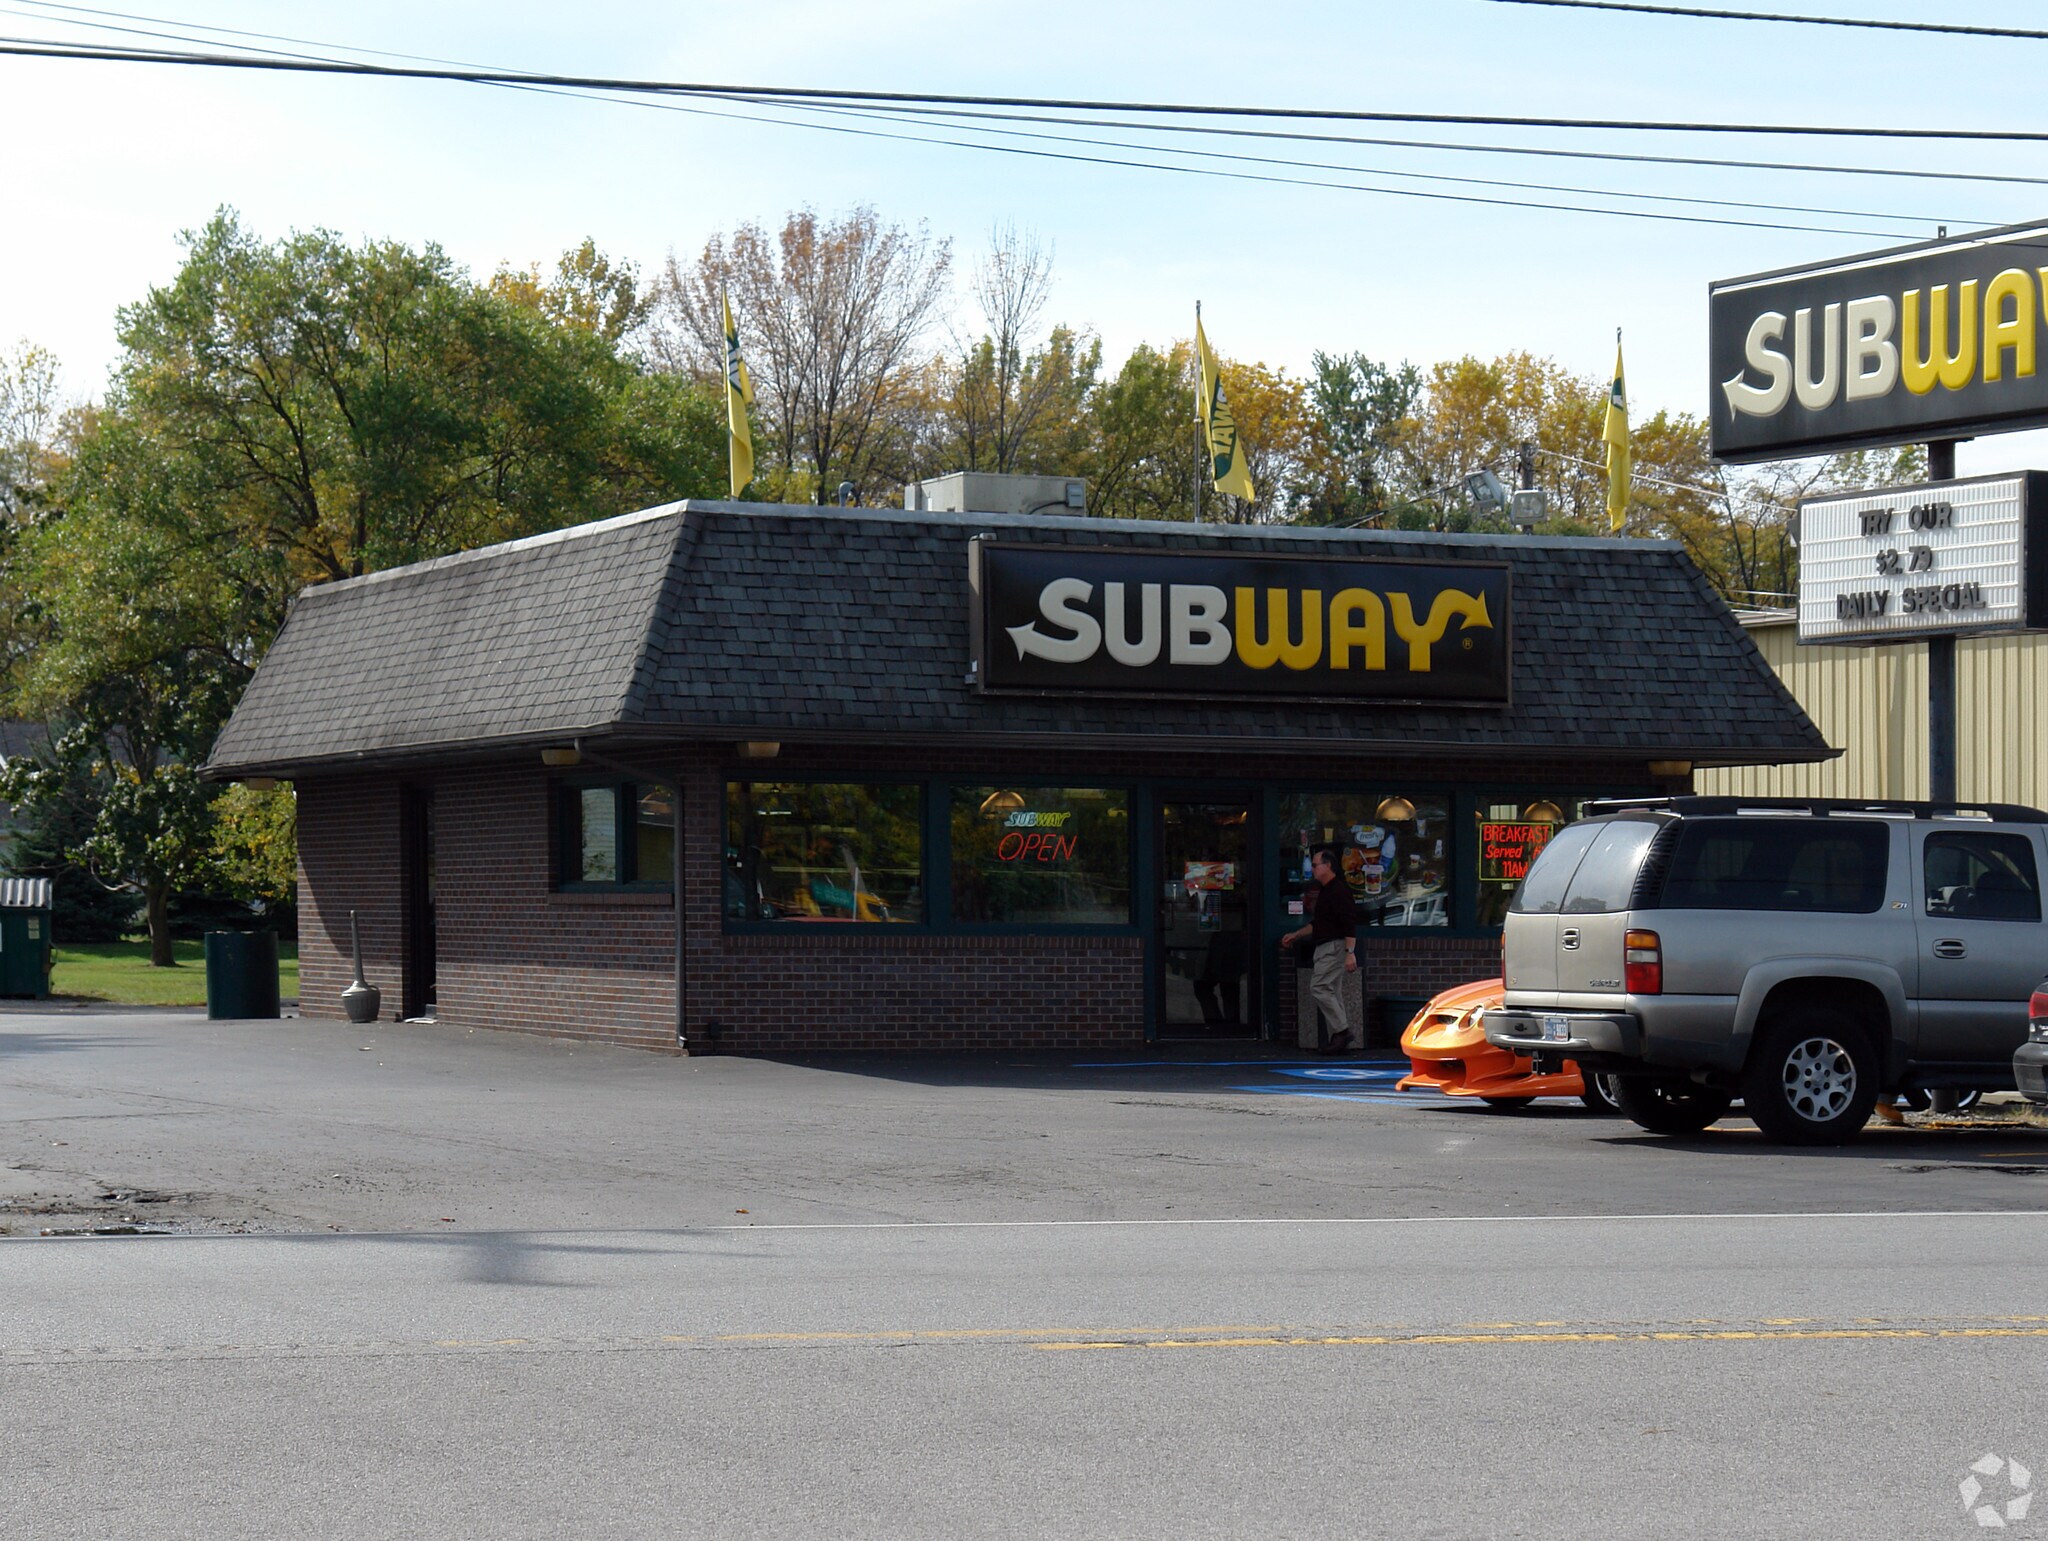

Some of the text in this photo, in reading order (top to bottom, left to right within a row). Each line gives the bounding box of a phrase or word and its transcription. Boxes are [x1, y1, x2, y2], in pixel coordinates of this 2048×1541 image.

[1722, 267, 2048, 422] SUBWA
[1859, 501, 1953, 536] TRY OUR
[1837, 582, 1986, 619] DAILY SPECIAL
[1005, 577, 1493, 672] SUBWAY
[1004, 811, 1071, 828] SUBWAY
[1483, 825, 1549, 843] BREAKFAST
[998, 832, 1078, 861] OPEN
[1485, 844, 1524, 859] Served
